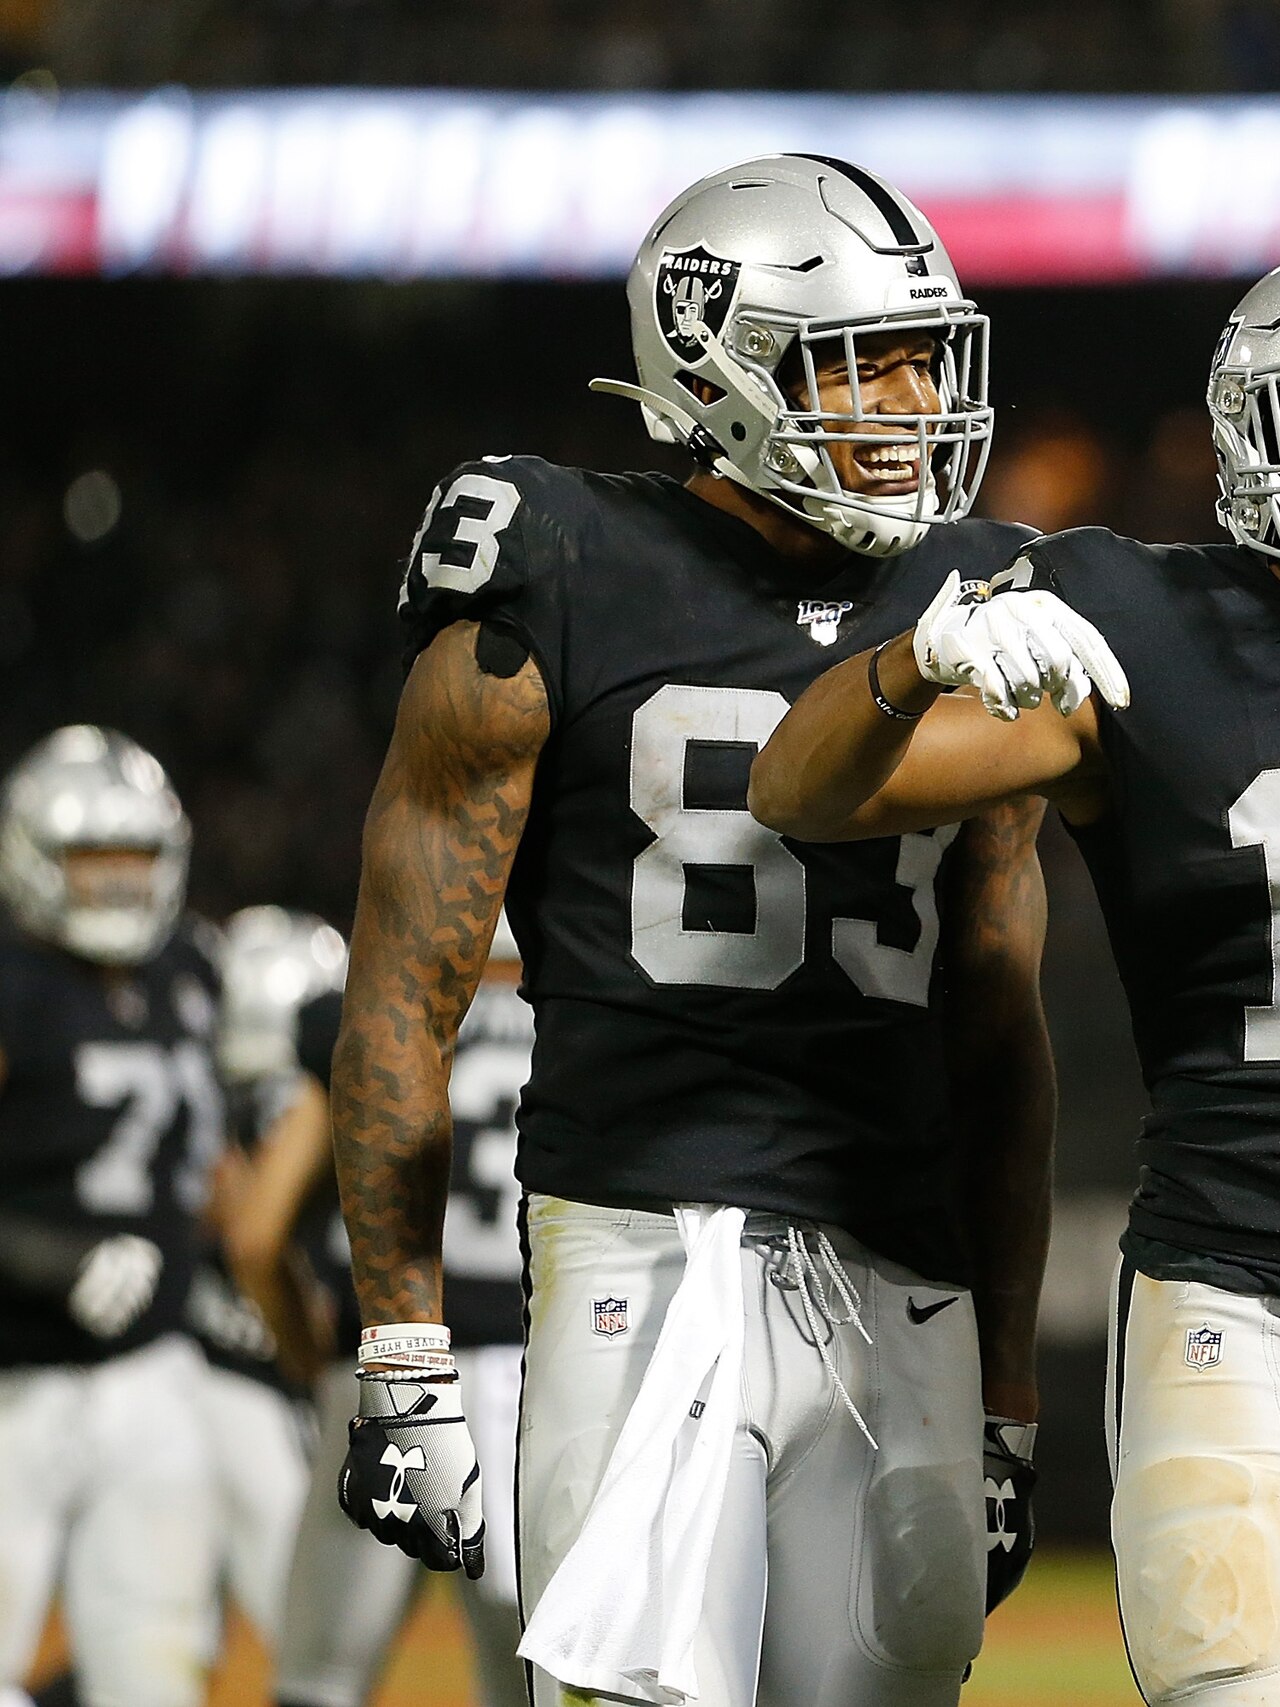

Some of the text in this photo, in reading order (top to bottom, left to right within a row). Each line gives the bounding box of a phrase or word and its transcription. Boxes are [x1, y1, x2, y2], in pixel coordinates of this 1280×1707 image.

[662, 254, 733, 276] RAIDERS
[909, 287, 948, 299] RAIDERS
[630, 684, 961, 1008] 83
[598, 1313, 629, 1332] NFL
[372, 1341, 401, 1354] HYPE
[1190, 1345, 1216, 1362] NFL
